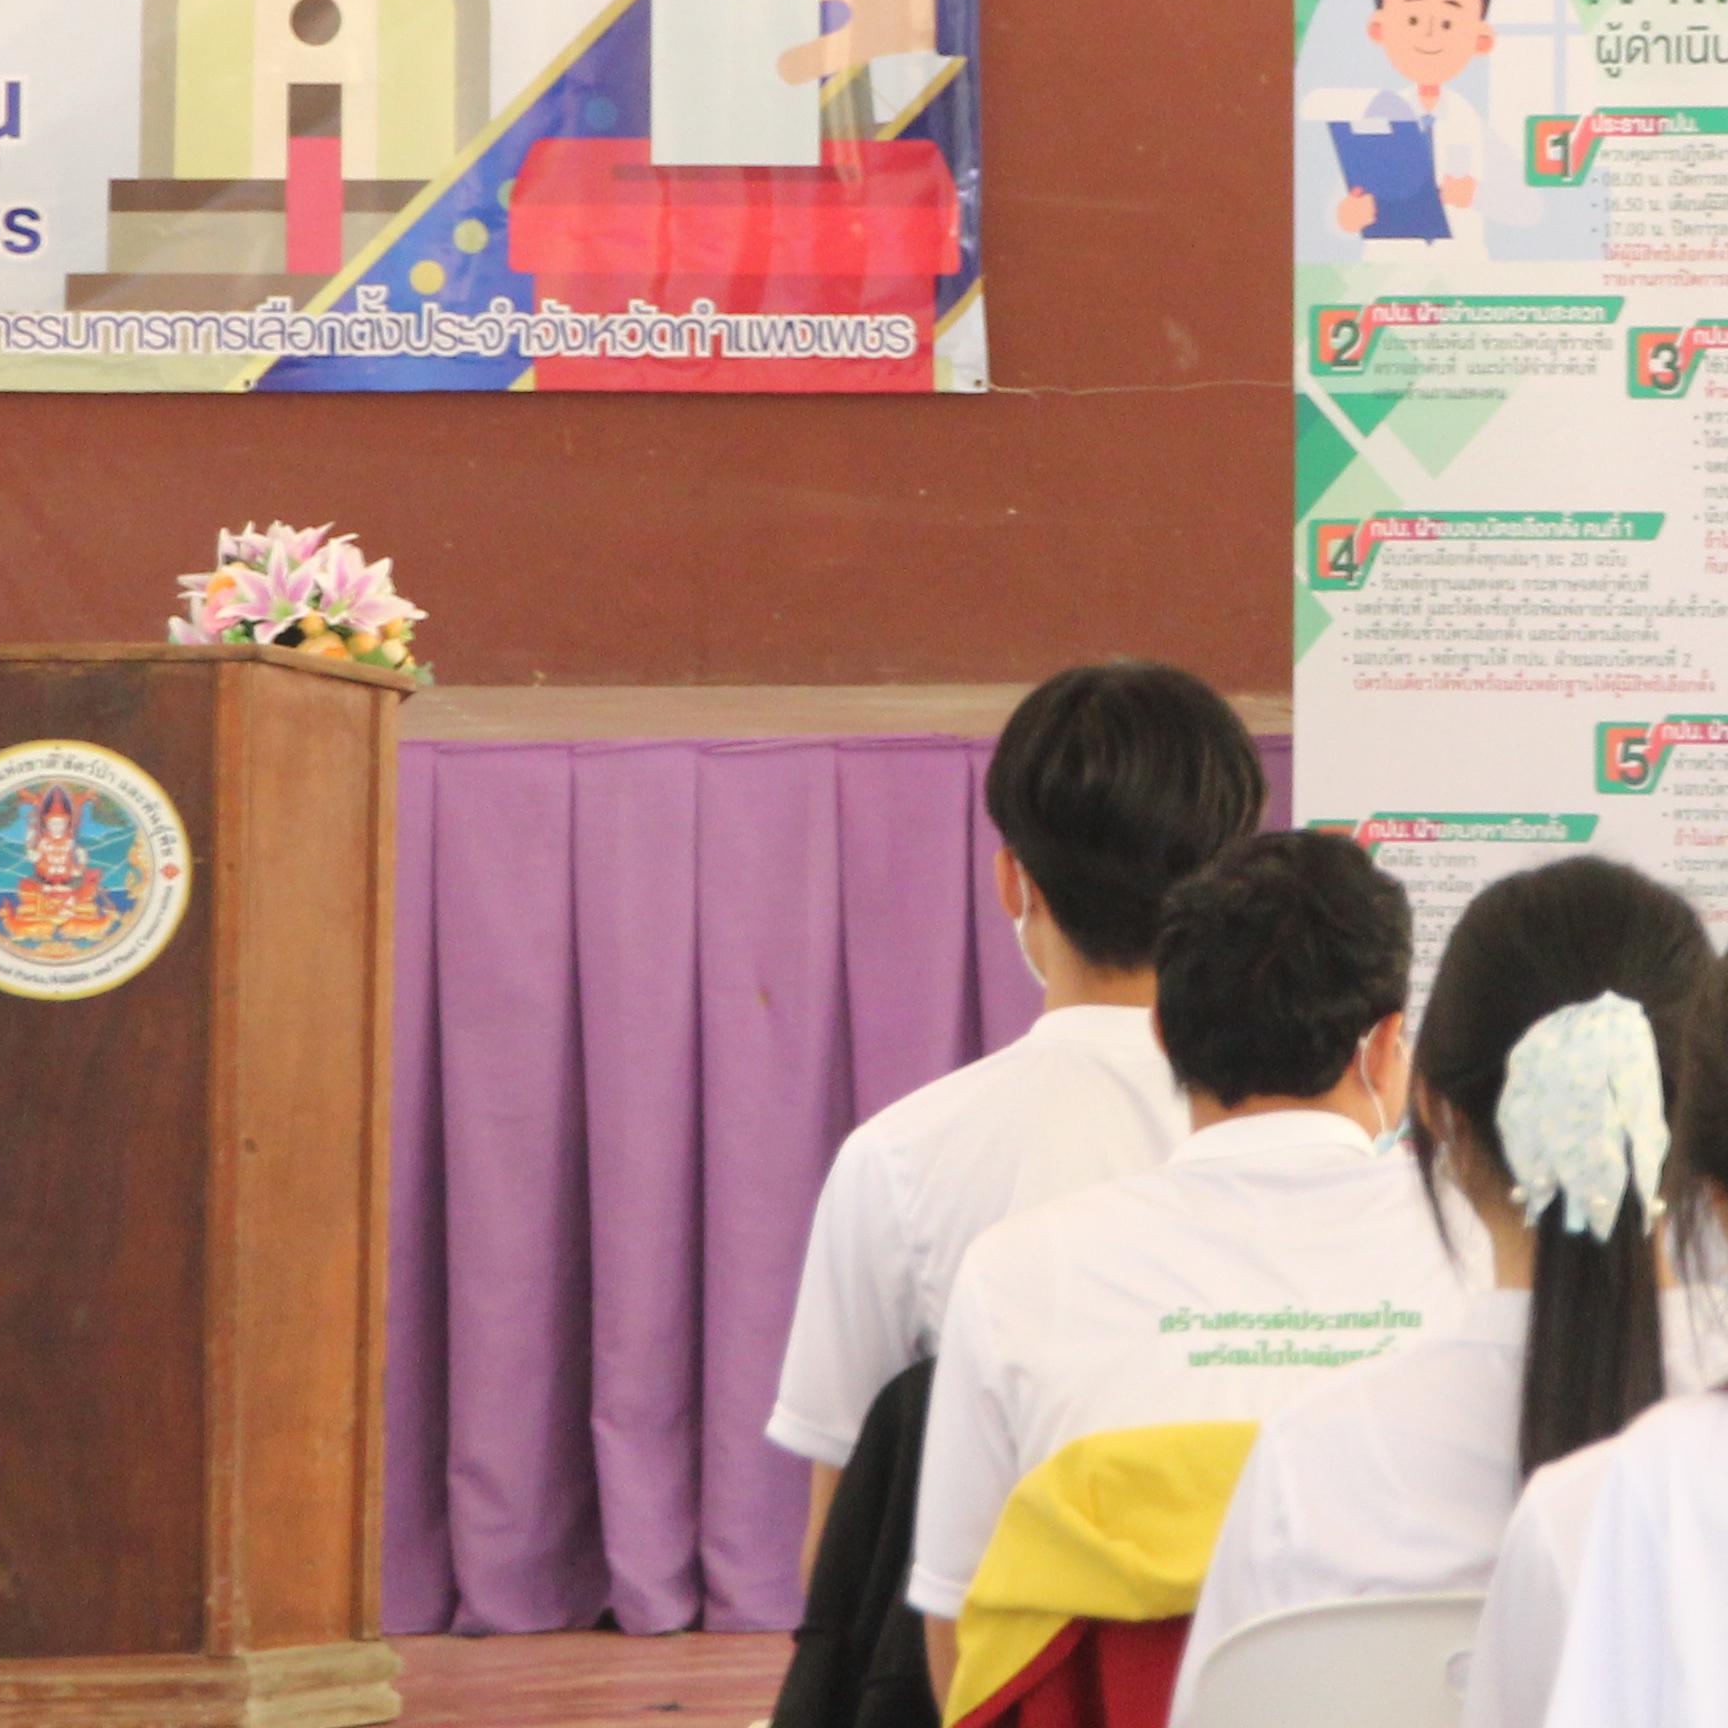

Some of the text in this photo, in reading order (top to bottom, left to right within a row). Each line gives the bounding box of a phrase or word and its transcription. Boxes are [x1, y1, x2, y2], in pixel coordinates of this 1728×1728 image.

[1330, 319, 1361, 368] 2
[1650, 343, 1682, 391] 3
[1329, 533, 1361, 582] 4
[1619, 735, 1652, 786] 5
